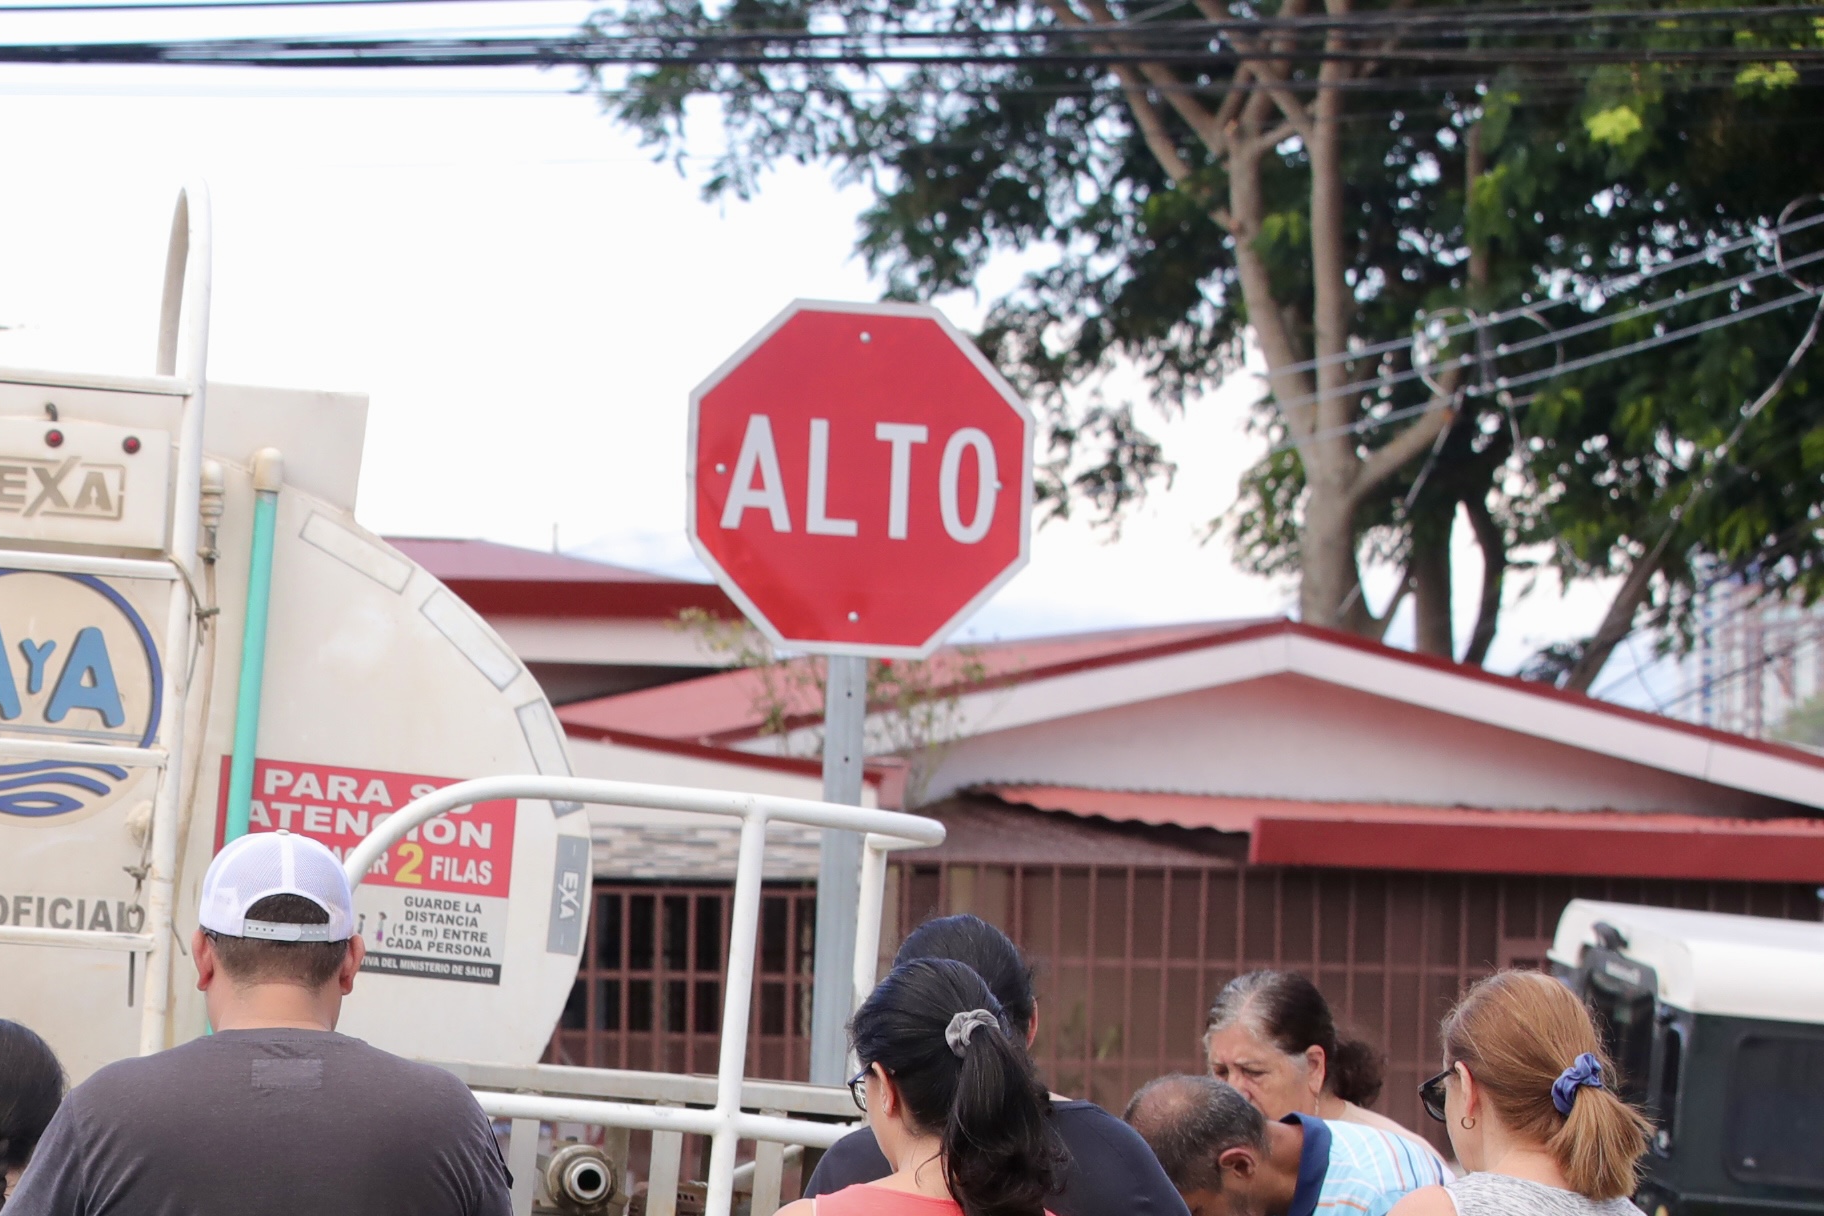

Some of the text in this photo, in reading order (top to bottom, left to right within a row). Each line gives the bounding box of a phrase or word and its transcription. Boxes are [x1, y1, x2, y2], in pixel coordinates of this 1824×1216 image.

[719, 413, 999, 545] ALTO
[263, 768, 394, 808] PARA
[394, 843, 424, 885] 2
[430, 855, 493, 886] FILAS
[404, 896, 482, 914] GUARDE LA
[558, 871, 580, 919] EXA
[405, 910, 479, 928] DISTANCIA
[392, 924, 489, 943] (1.5 m) ENTRE
[385, 937, 493, 958] CADA PERSONA
[381, 957, 398, 969] DEL
[399, 959, 451, 975] MINISTERIO
[451, 965, 464, 975] DE
[464, 966, 494, 979] SALUD
